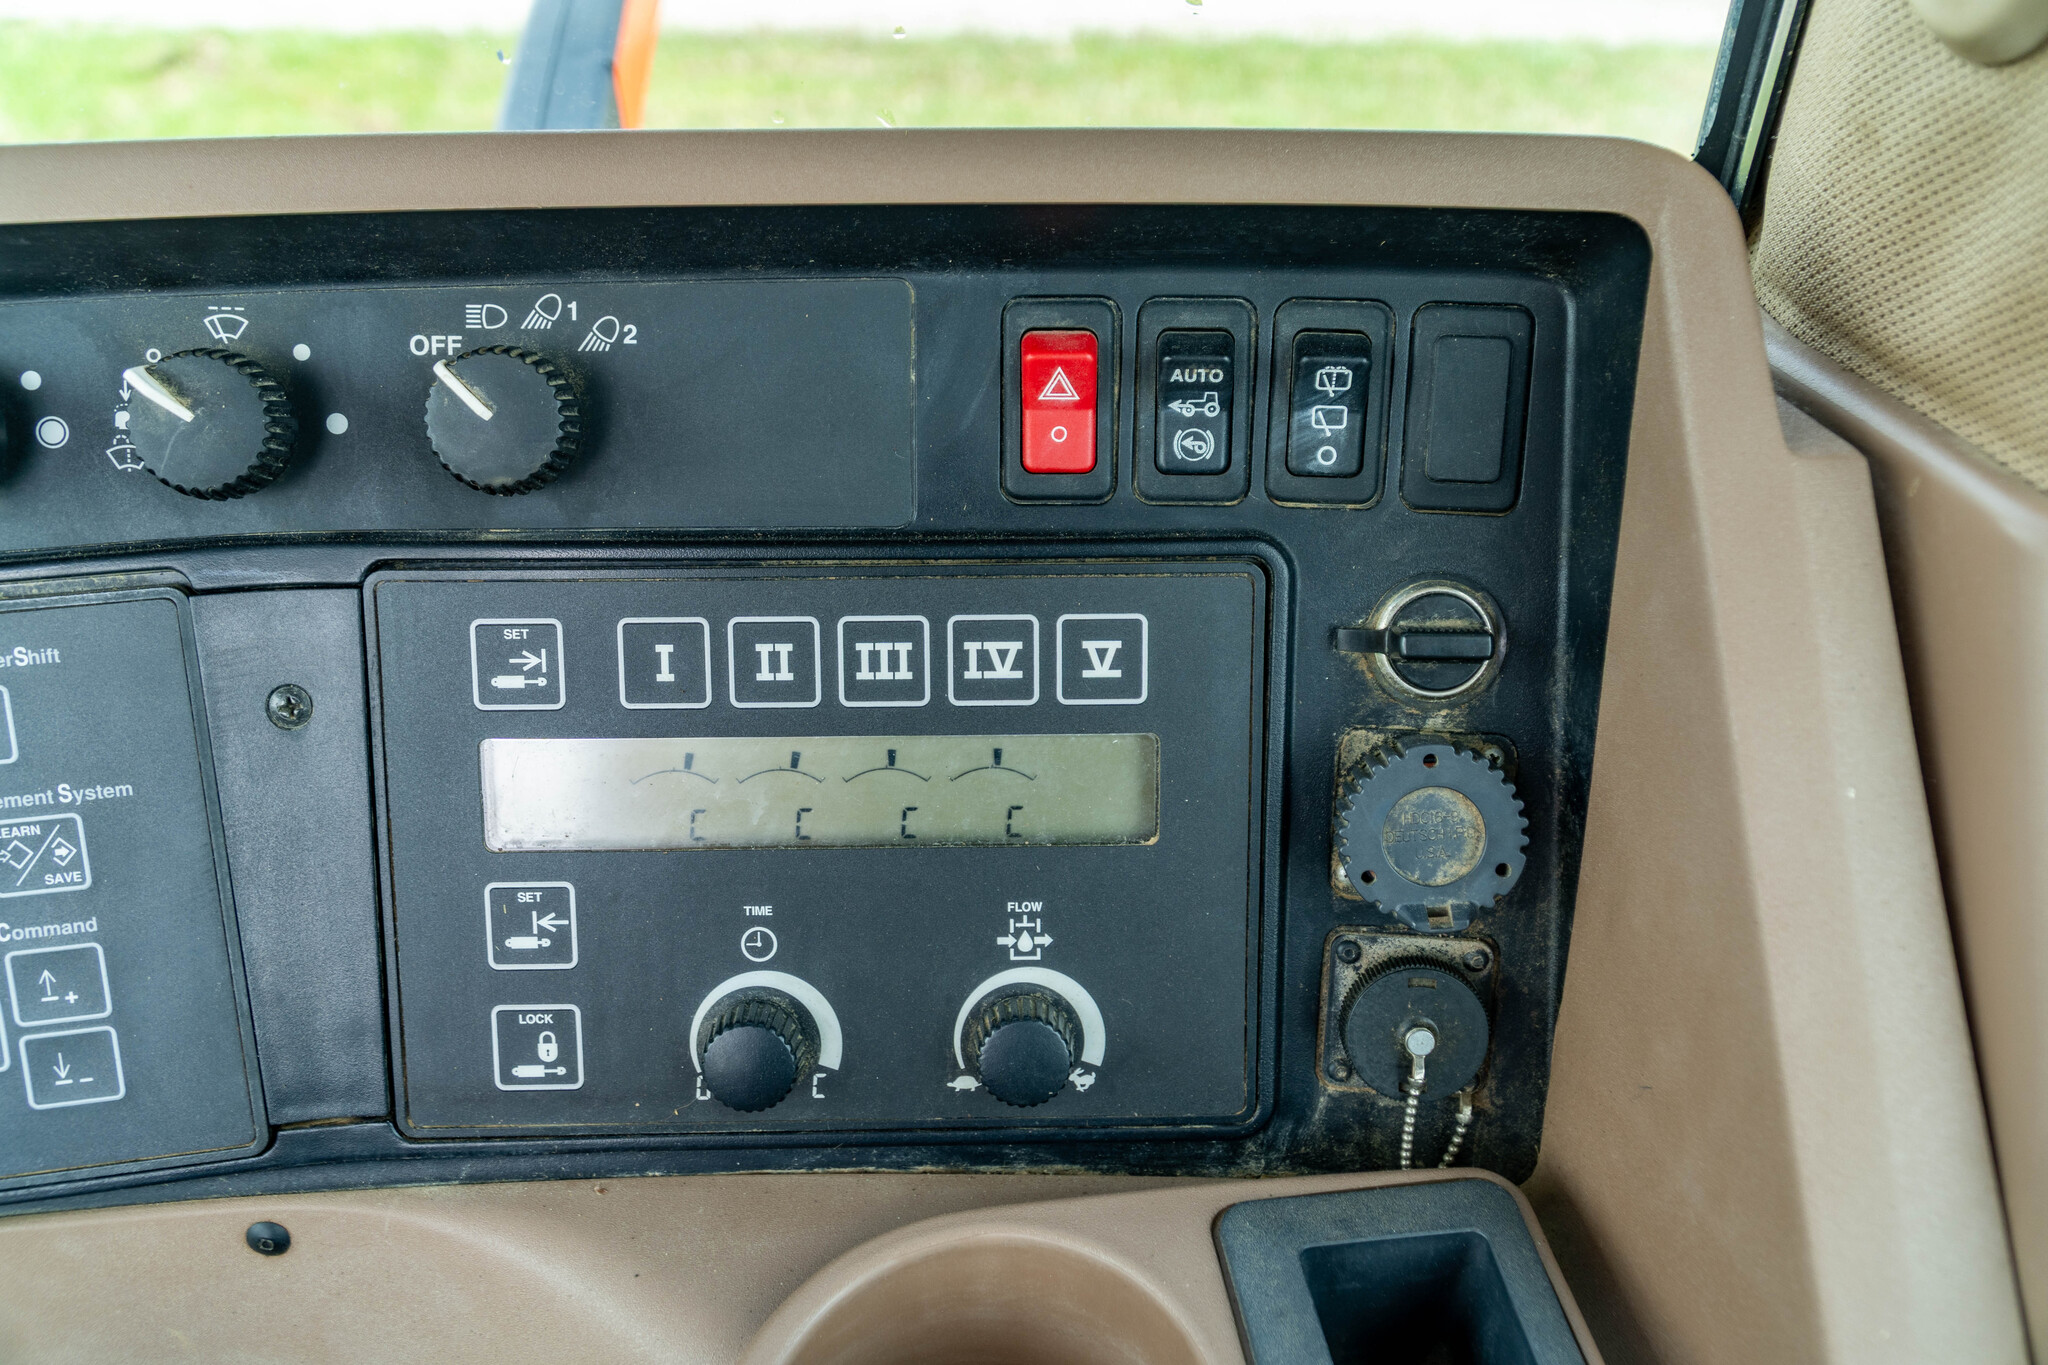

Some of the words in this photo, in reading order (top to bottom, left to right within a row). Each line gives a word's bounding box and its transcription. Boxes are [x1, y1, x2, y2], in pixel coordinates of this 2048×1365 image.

[567, 300, 577, 321] 1
[622, 324, 638, 344] 2
[409, 334, 463, 356] OFF
[1169, 368, 1224, 383] AUTO
[503, 628, 530, 640] SET
[754, 643, 794, 681] II
[855, 642, 913, 680] III
[963, 641, 1024, 679] IV
[1081, 640, 1123, 678] V
[57, 783, 134, 806] System
[0, 824, 41, 839] EARN
[44, 871, 83, 885] SAVE
[516, 891, 543, 903] SET
[1007, 901, 1043, 913] FLOW
[742, 905, 773, 917] TIME
[0, 916, 98, 942] Command
[518, 1013, 554, 1025] LOCK
